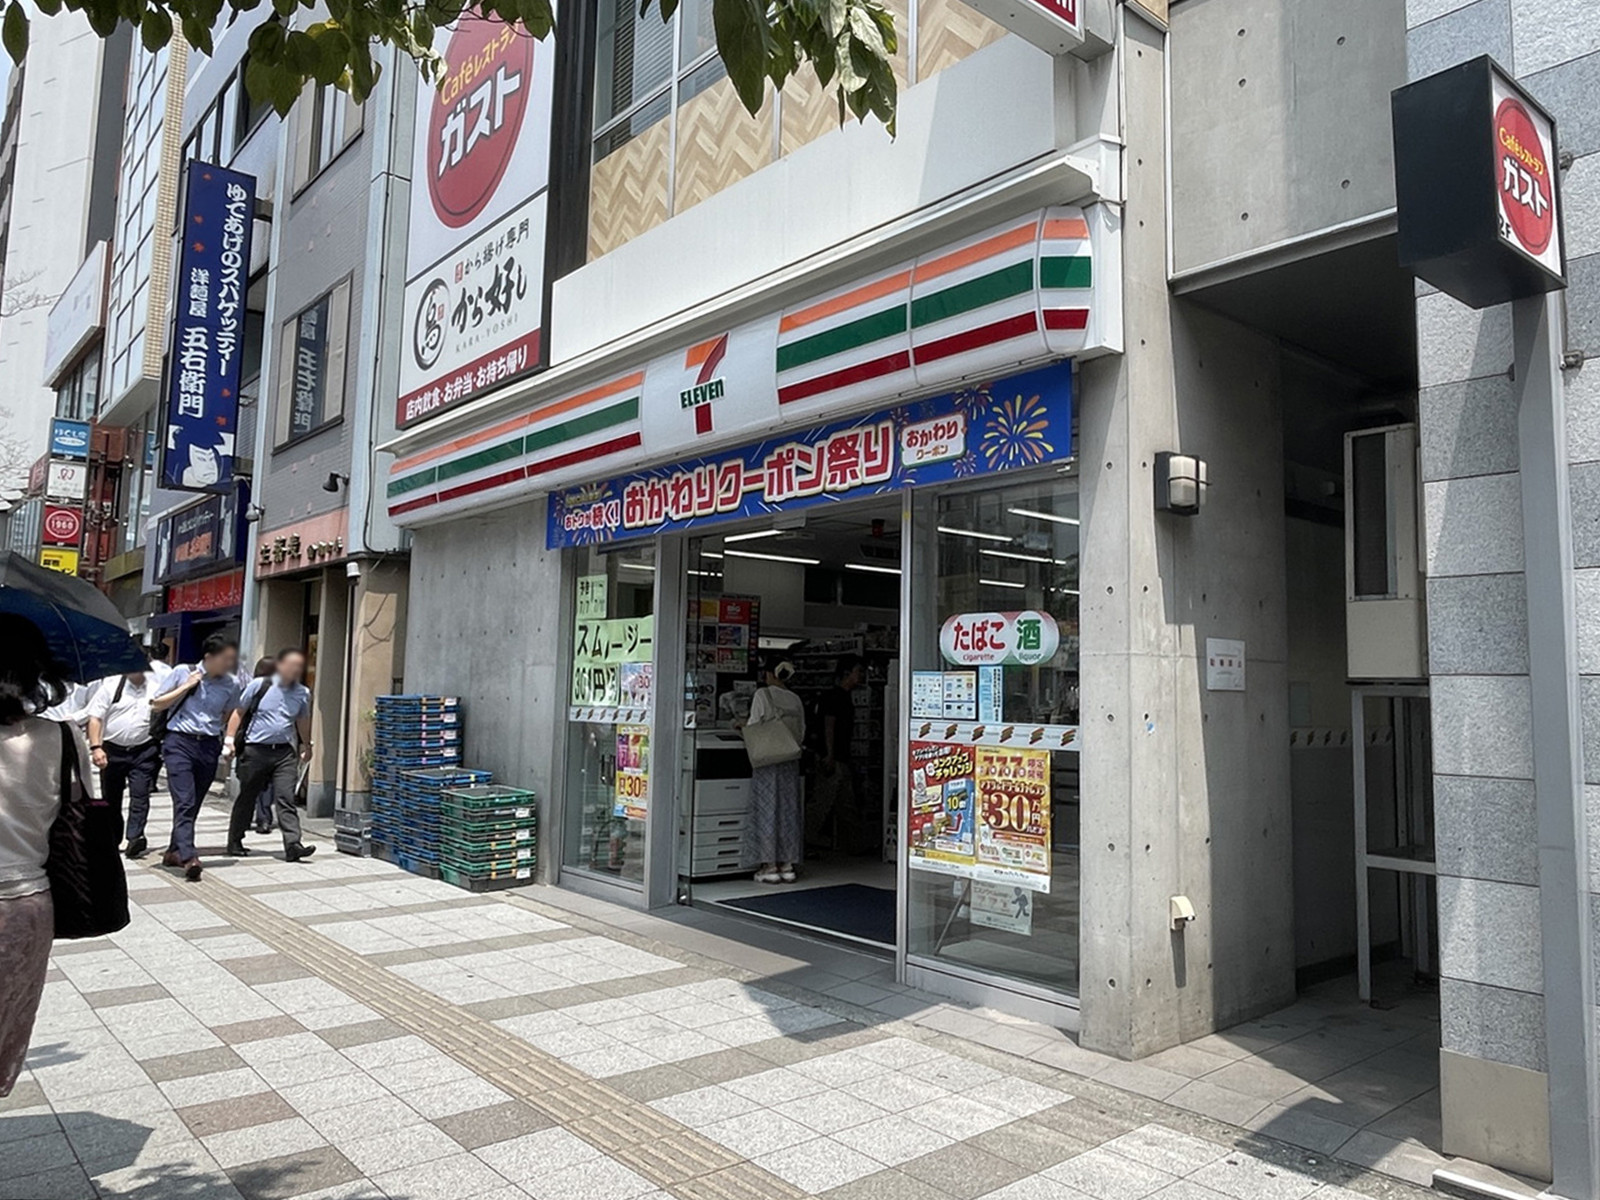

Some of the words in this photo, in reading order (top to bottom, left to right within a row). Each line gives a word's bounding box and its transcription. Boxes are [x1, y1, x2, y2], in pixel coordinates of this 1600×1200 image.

[438, 65, 521, 178] ガスト
[1498, 127, 1544, 175] Caféレストラン
[1503, 155, 1548, 218] ガスト
[465, 218, 529, 275] から揚げ専門
[189, 268, 209, 318] 洋麺屋
[216, 184, 248, 377] ゆであげのスパゲッティー
[451, 256, 527, 334] から好し
[455, 313, 519, 353] KARA-YOSHI
[178, 327, 209, 419] 五右衛門
[684, 331, 730, 435] 7
[905, 420, 958, 449] おかわり
[915, 444, 949, 461] クーポン
[622, 421, 894, 530] おかわりクーポン祭り
[953, 619, 1006, 652] たばこ
[962, 652, 995, 663] cigarette
[1016, 618, 1041, 651] 酒
[1019, 651, 1042, 662] liquor
[988, 791, 1031, 832] 30
